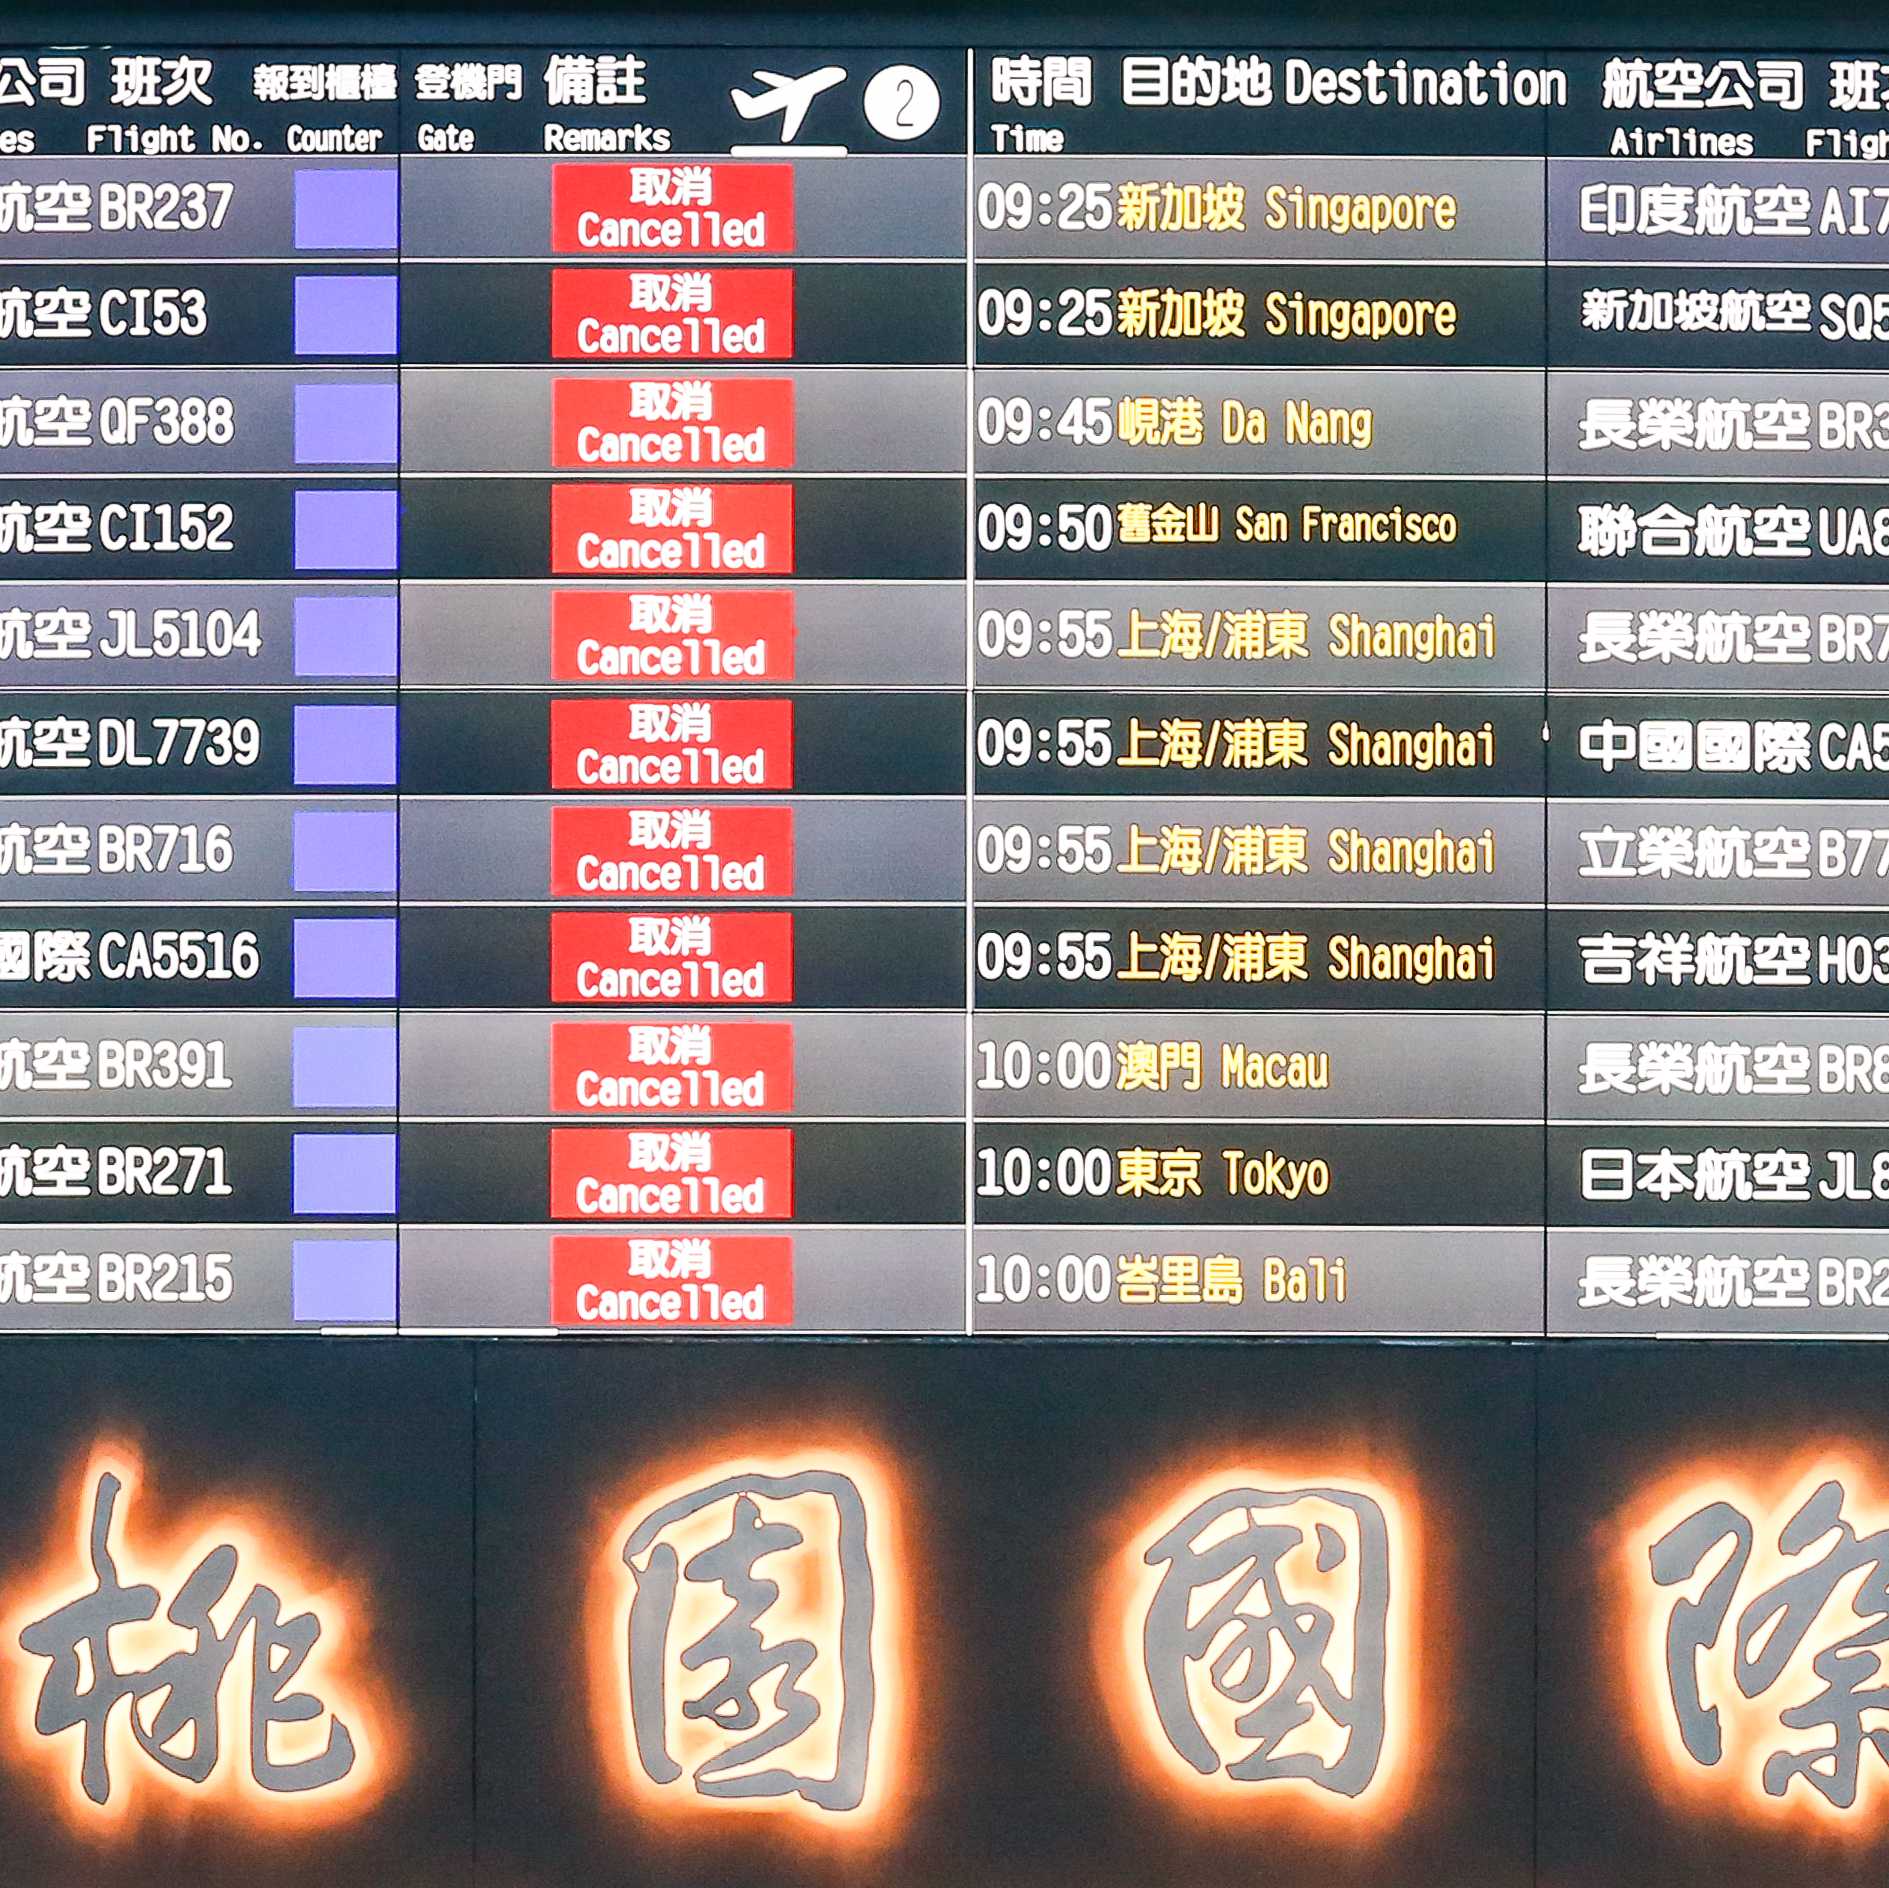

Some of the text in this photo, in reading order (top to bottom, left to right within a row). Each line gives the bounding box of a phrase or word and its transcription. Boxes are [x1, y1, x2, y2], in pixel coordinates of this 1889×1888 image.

[100, 182, 234, 230] BR237
[629, 167, 712, 205] 取消
[978, 182, 1113, 230] 09:25
[1117, 181, 1245, 232] 新加坡
[1265, 185, 1457, 234] Singapore
[1581, 182, 1811, 236] 印度航空
[578, 212, 764, 250] Cancelled
[100, 503, 233, 551] CI152
[978, 503, 1112, 551] 09:50
[1117, 502, 1219, 543] 舊金山
[1235, 505, 1288, 541] San
[1303, 505, 1457, 542] Francisco
[1578, 503, 1811, 557] 聯合航空
[99, 931, 259, 979] CA5516
[977, 1254, 1111, 1303] 10:00
[1116, 1251, 1243, 1305] 峇里島
[1264, 1256, 1347, 1302] Bali
[1578, 1254, 1811, 1308] 長榮航空
